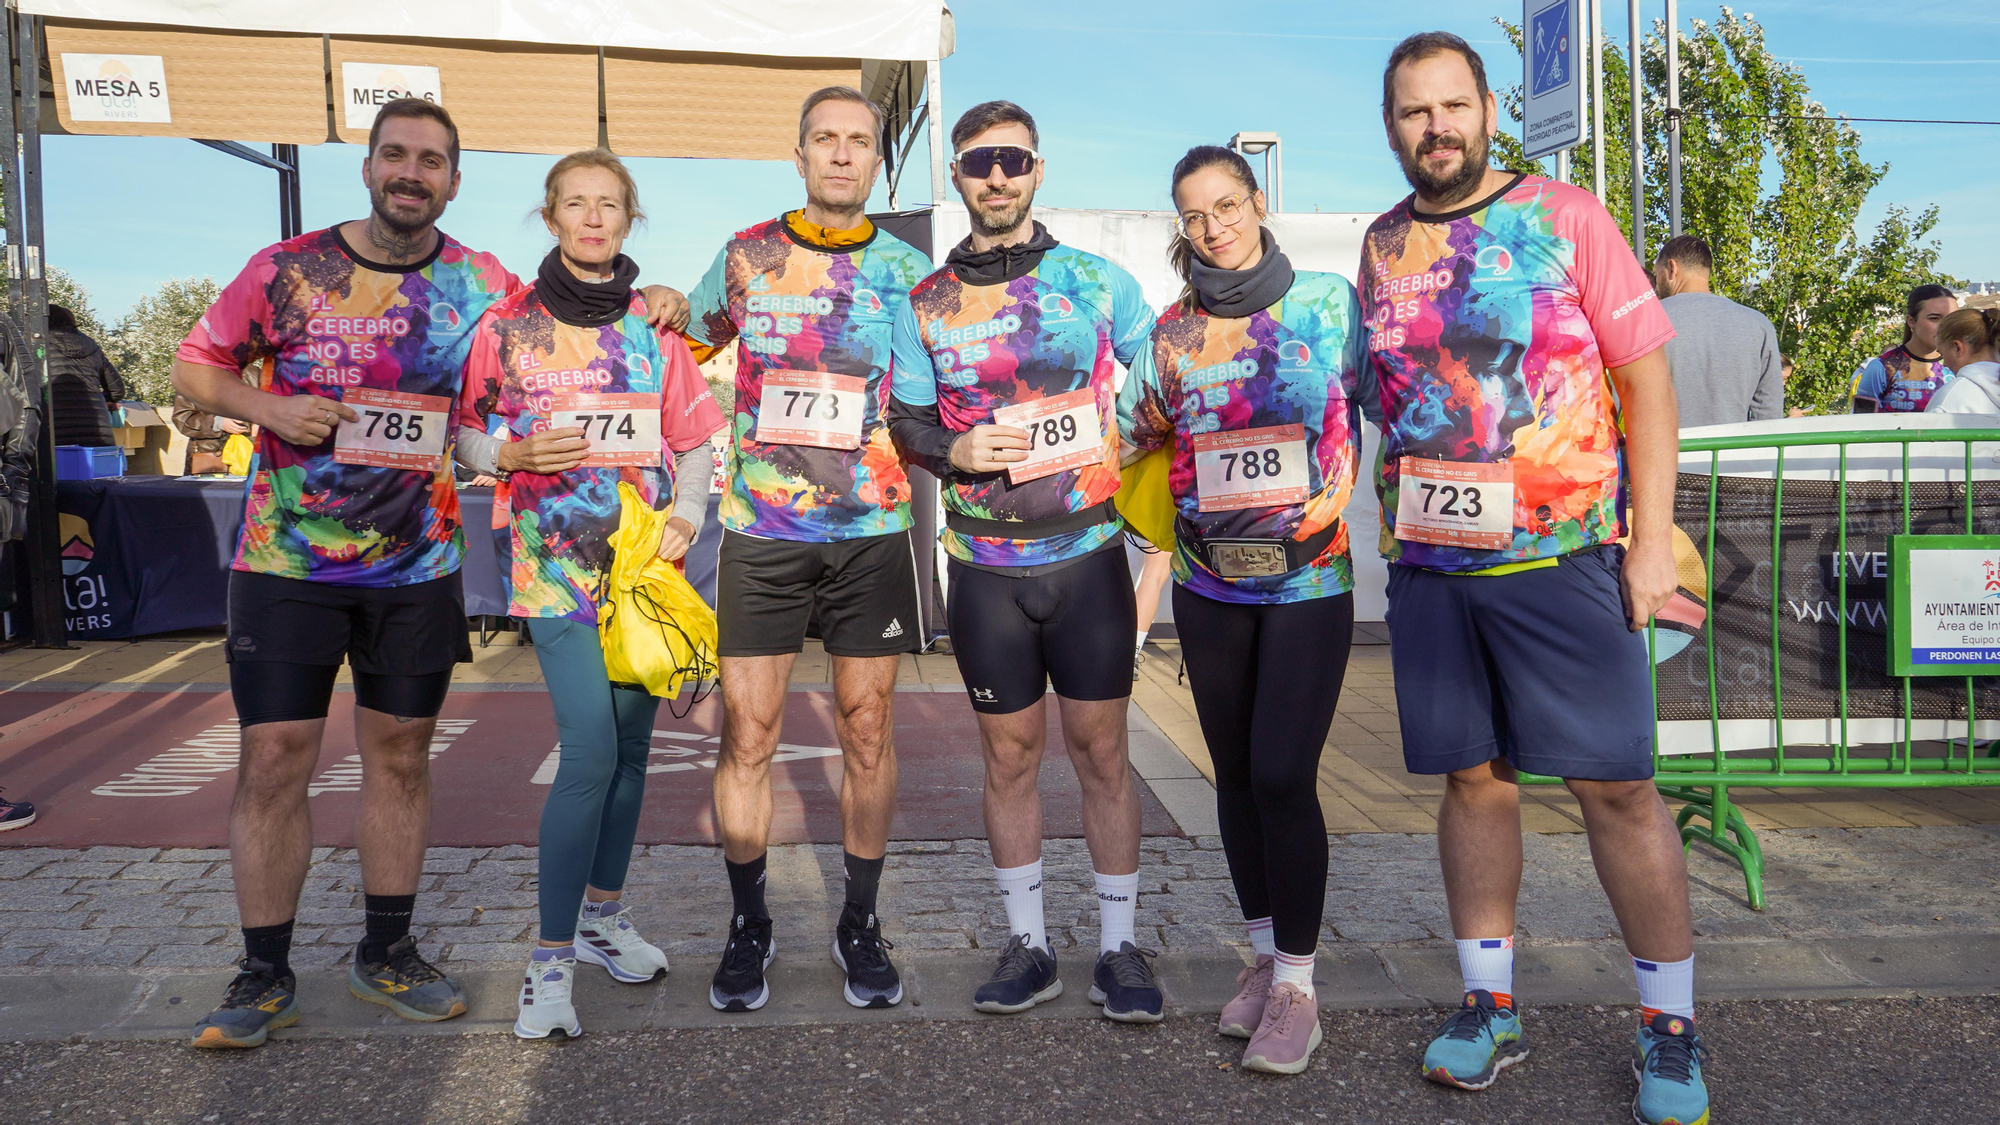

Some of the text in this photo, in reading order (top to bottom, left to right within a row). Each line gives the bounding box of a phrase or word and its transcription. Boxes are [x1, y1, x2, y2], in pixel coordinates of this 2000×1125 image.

[75, 79, 160, 98] MESA 5
[104, 110, 138, 118] RIVERS
[1530, 110, 1573, 132] ZONA COMPARTIDA
[1526, 120, 1576, 144] PRIORIDAD PEATONAL
[1376, 261, 1390, 278] EL
[750, 274, 768, 290] EL
[1374, 270, 1450, 301] CEREBRO
[311, 294, 332, 310] EL
[748, 297, 832, 314] CEREBRO
[1042, 316, 1079, 326] astucespain
[1373, 300, 1418, 326] NO ES
[308, 318, 408, 334] CEREBRO
[746, 317, 801, 333] NO ES
[746, 338, 786, 353] GRIS
[1368, 329, 1404, 350] GRIS
[309, 343, 376, 359] NO ES
[962, 344, 988, 363] ES
[520, 354, 540, 370] EL
[311, 368, 362, 384] GRIS
[522, 370, 610, 391] CEREBRO
[1182, 360, 1256, 393] CEREBRO
[1206, 388, 1228, 406] ES
[1908, 391, 1922, 400] ES
[526, 396, 552, 414] NO
[784, 390, 839, 420] 773
[1890, 401, 1915, 410] GRIS
[365, 410, 424, 442] 785
[575, 413, 636, 440] 774
[1025, 414, 1076, 451] 789
[1187, 414, 1218, 434] GRIS
[1220, 448, 1282, 482] 788
[1422, 467, 1444, 475] CEREBRO
[1420, 483, 1482, 518] 723
[62, 574, 108, 610] la!
[65, 614, 112, 632] VERS
[1937, 618, 1965, 631] Área
[1969, 621, 1983, 631] de
[882, 629, 904, 638] adidas
[1962, 636, 1994, 645] Equipo
[1930, 652, 1982, 660] PERDONEN
[1098, 892, 1128, 902] didas
